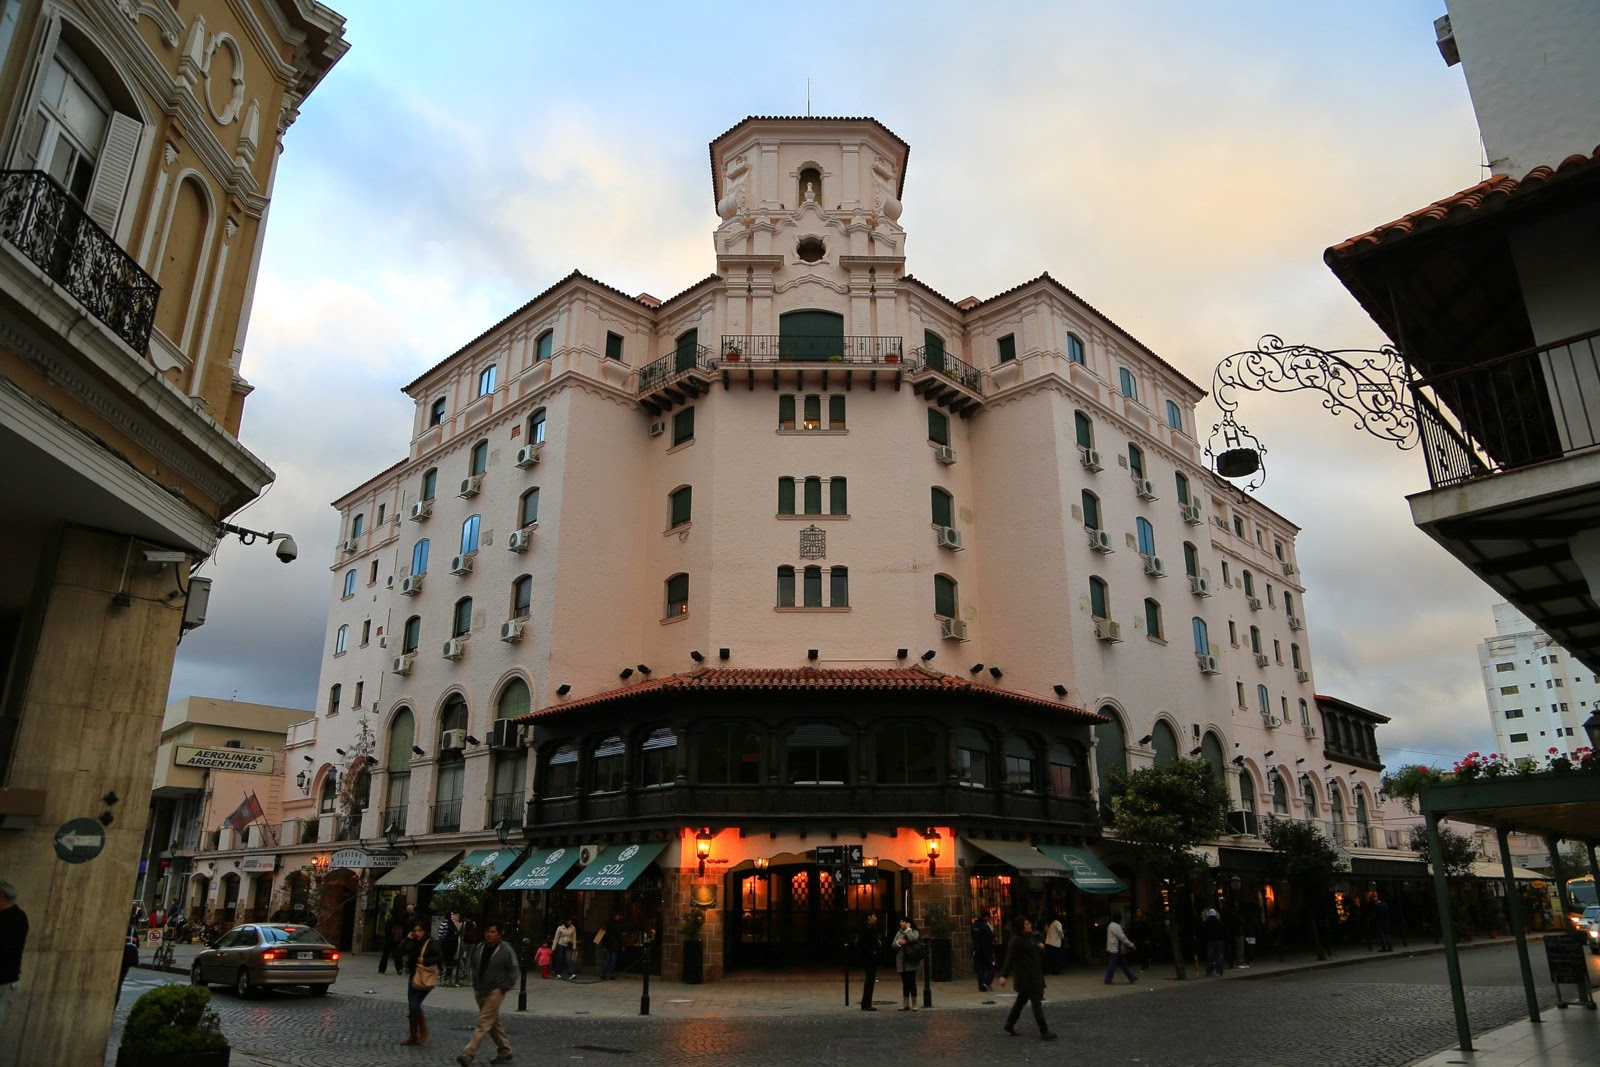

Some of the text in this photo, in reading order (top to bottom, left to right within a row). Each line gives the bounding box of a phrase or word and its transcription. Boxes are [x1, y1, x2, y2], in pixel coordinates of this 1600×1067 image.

[1224, 429, 1240, 447] H
[195, 751, 264, 763] AEROLINEAS
[187, 757, 258, 770] ARGENTINAS
[337, 851, 363, 859] TURISMO
[527, 866, 551, 877] SOL
[598, 864, 624, 875] SOL
[509, 878, 549, 887] PLATERIA
[580, 877, 624, 886] PLATERIA
